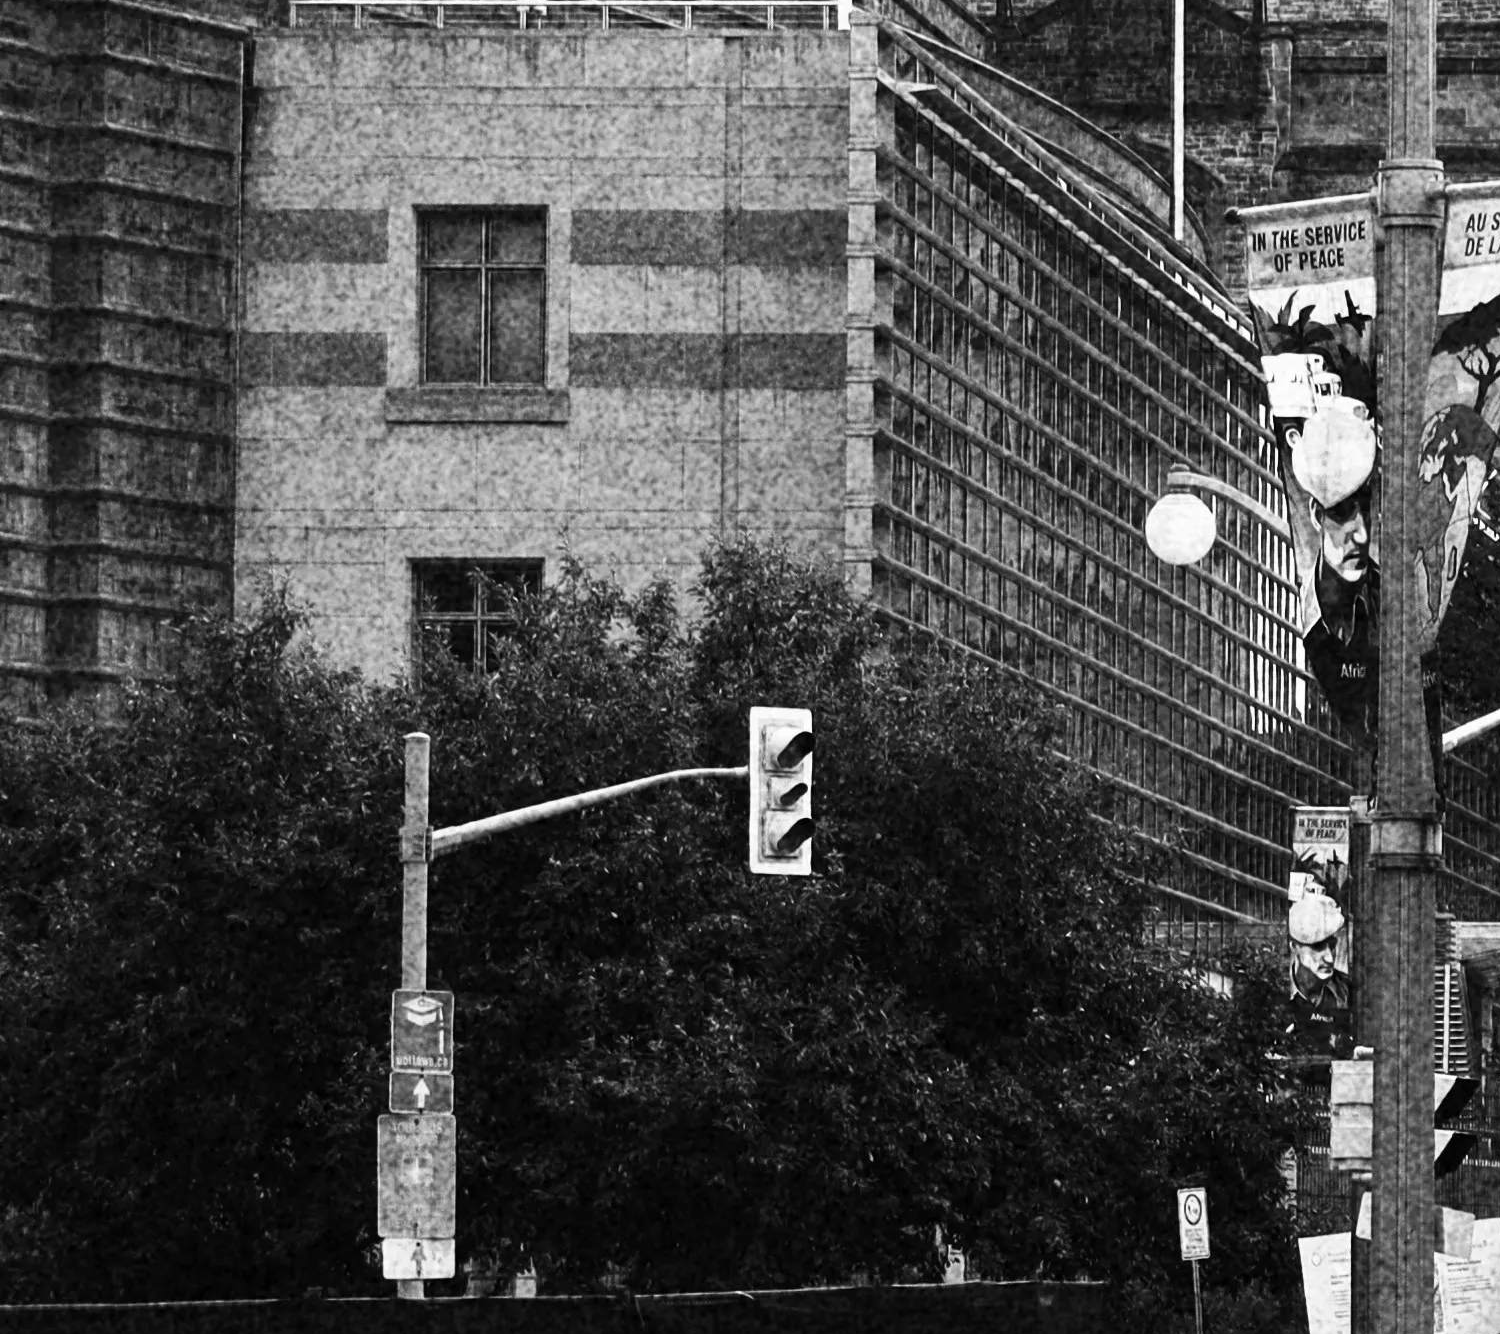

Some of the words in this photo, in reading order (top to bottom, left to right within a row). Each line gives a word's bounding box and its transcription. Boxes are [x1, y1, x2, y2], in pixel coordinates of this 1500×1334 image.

[1465, 213, 1486, 233] AU
[1252, 232, 1267, 252] IN
[1272, 228, 1300, 249] THE
[1305, 220, 1367, 246] SERVICE
[1464, 236, 1484, 257] DE
[1274, 253, 1293, 273] OF
[1299, 248, 1345, 270] PEACE
